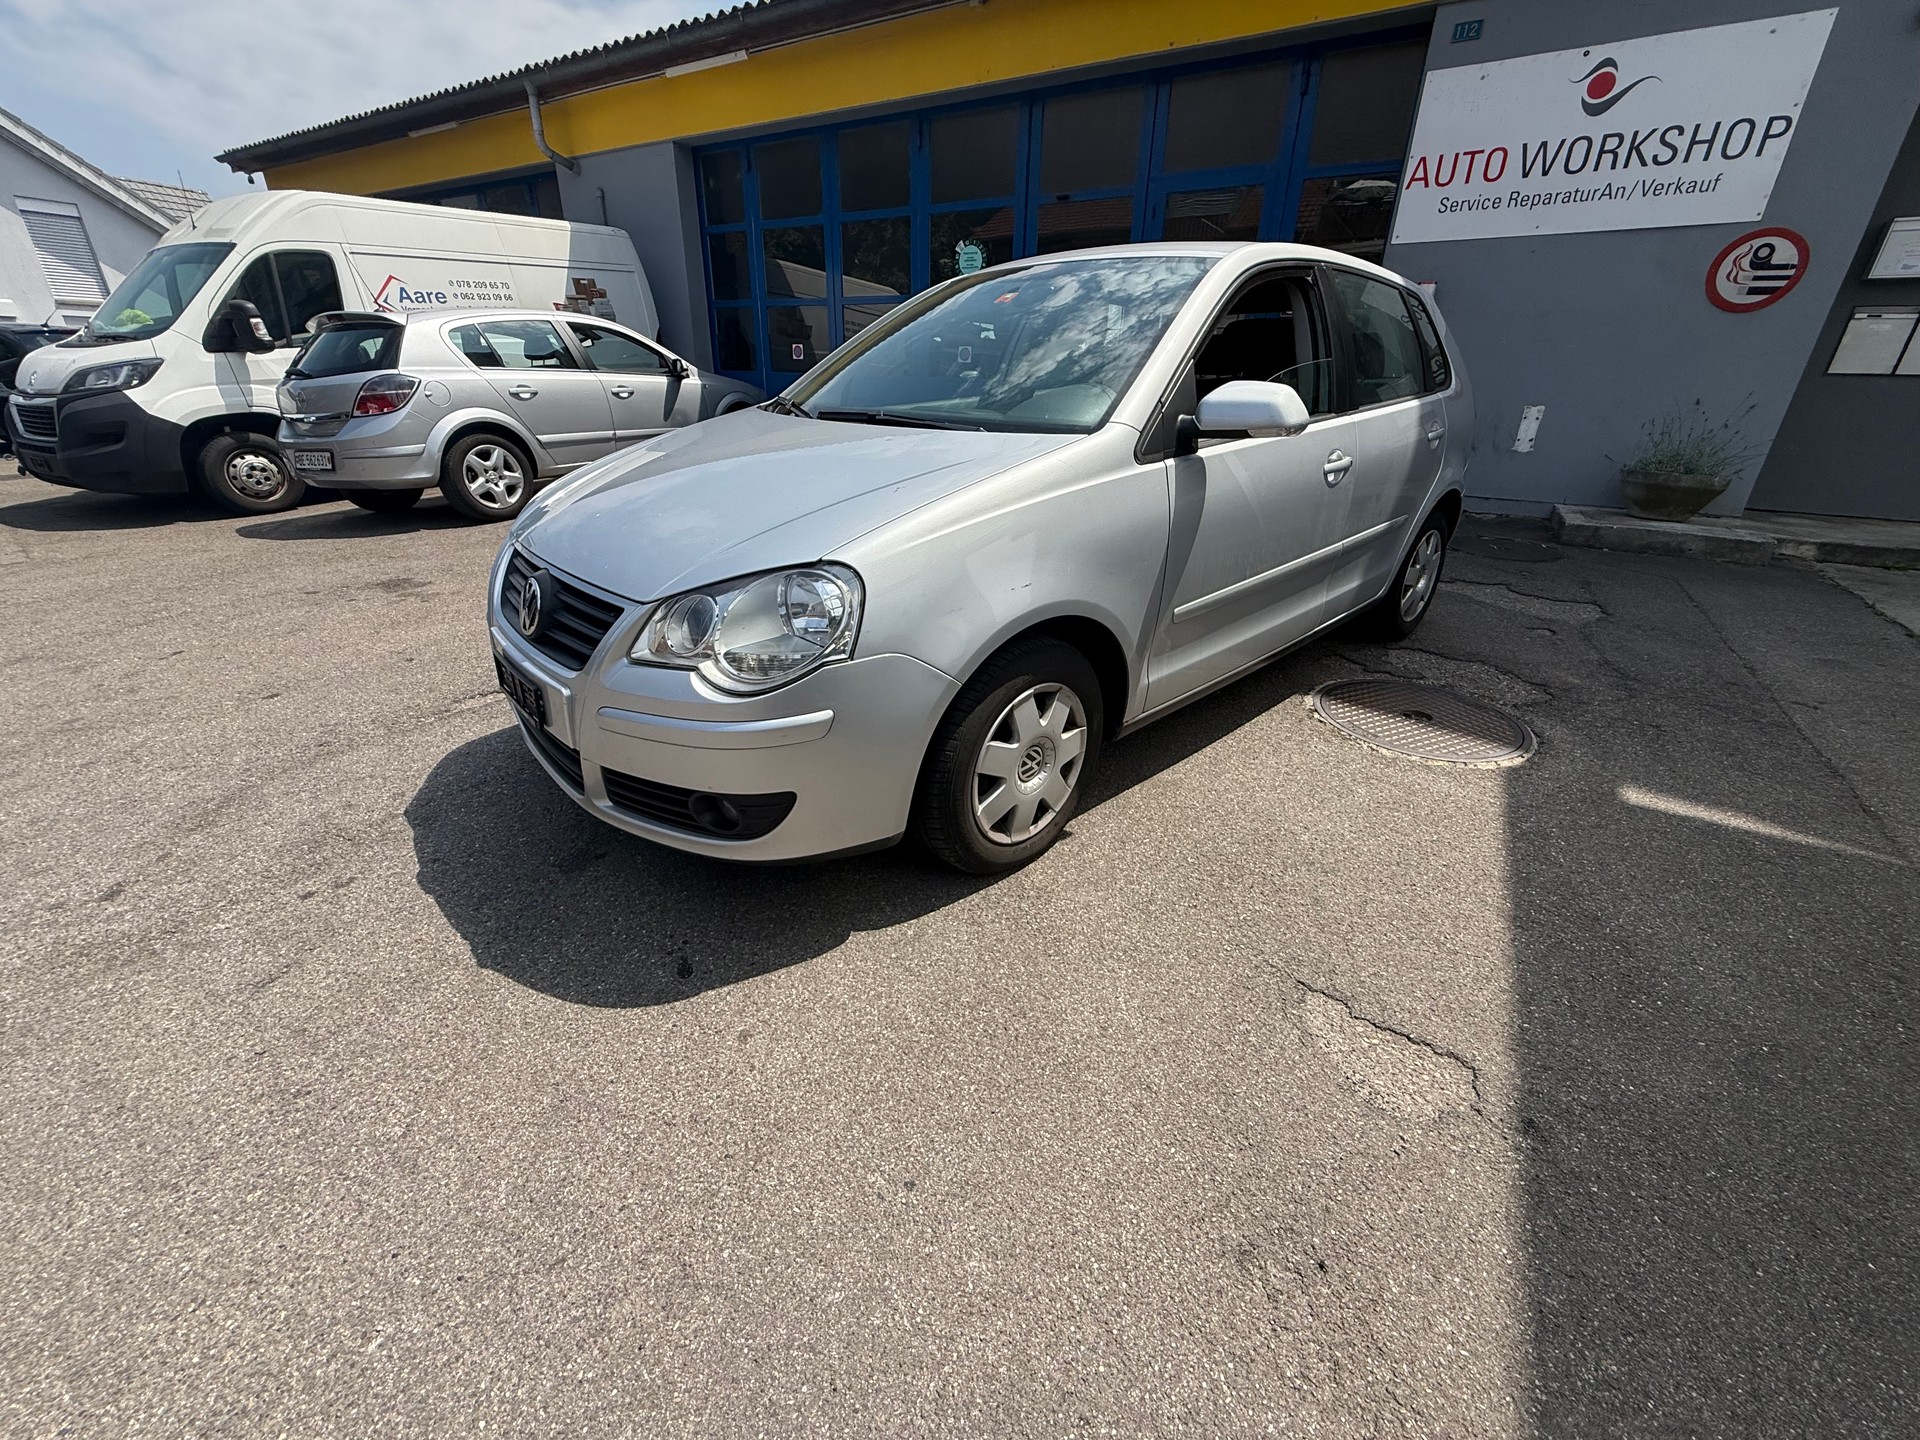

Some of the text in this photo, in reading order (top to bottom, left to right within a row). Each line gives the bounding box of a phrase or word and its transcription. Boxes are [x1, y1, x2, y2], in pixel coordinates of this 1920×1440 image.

[1455, 23, 1479, 39] 112
[1404, 114, 1794, 190] AUTO WORKSHOP
[1437, 193, 1502, 214] Service
[456, 280, 510, 290] 078 209 65 70
[399, 286, 448, 304] Aare
[460, 292, 475, 301] 062
[476, 293, 491, 301] 923
[492, 293, 503, 301] 09
